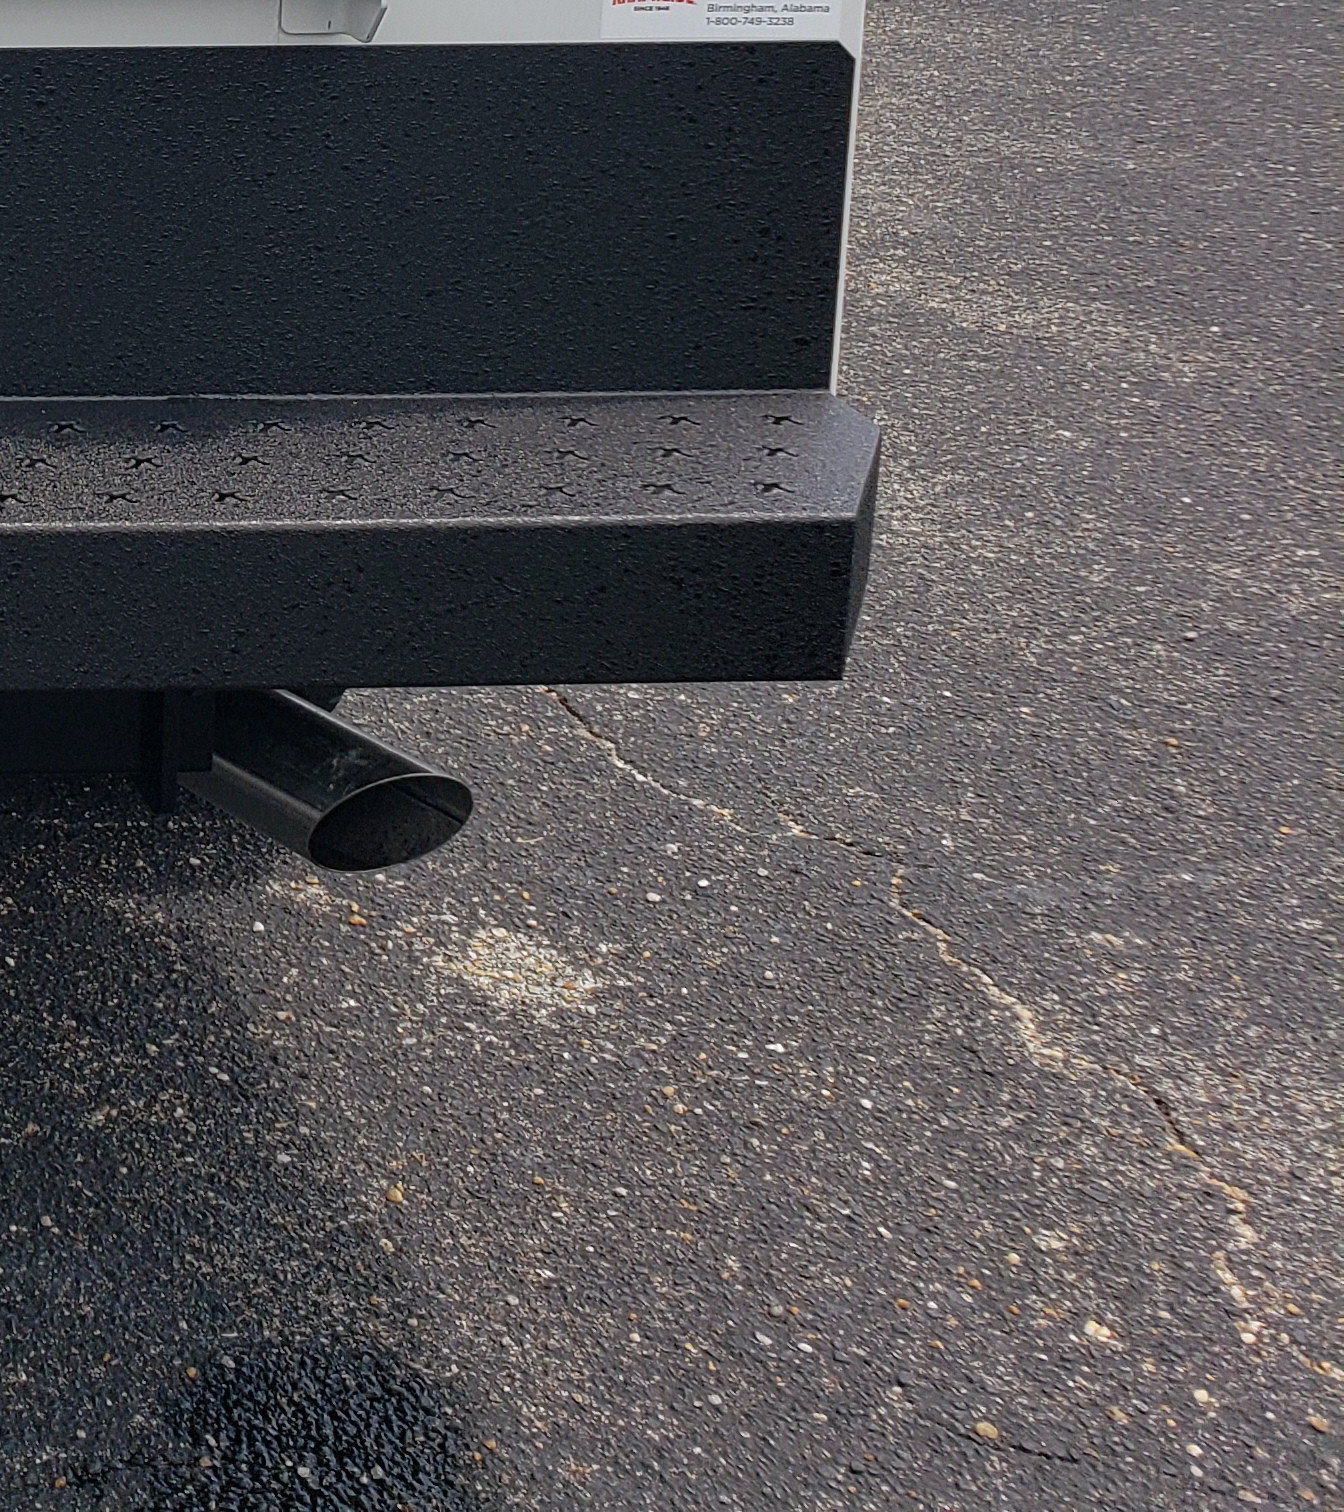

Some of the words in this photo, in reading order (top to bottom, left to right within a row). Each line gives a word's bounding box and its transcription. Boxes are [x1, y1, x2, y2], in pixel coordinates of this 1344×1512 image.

[707, 3, 778, 14] Birmingham,
[781, 3, 830, 13] Alabama
[705, 16, 795, 26] 1-800-749-3238
